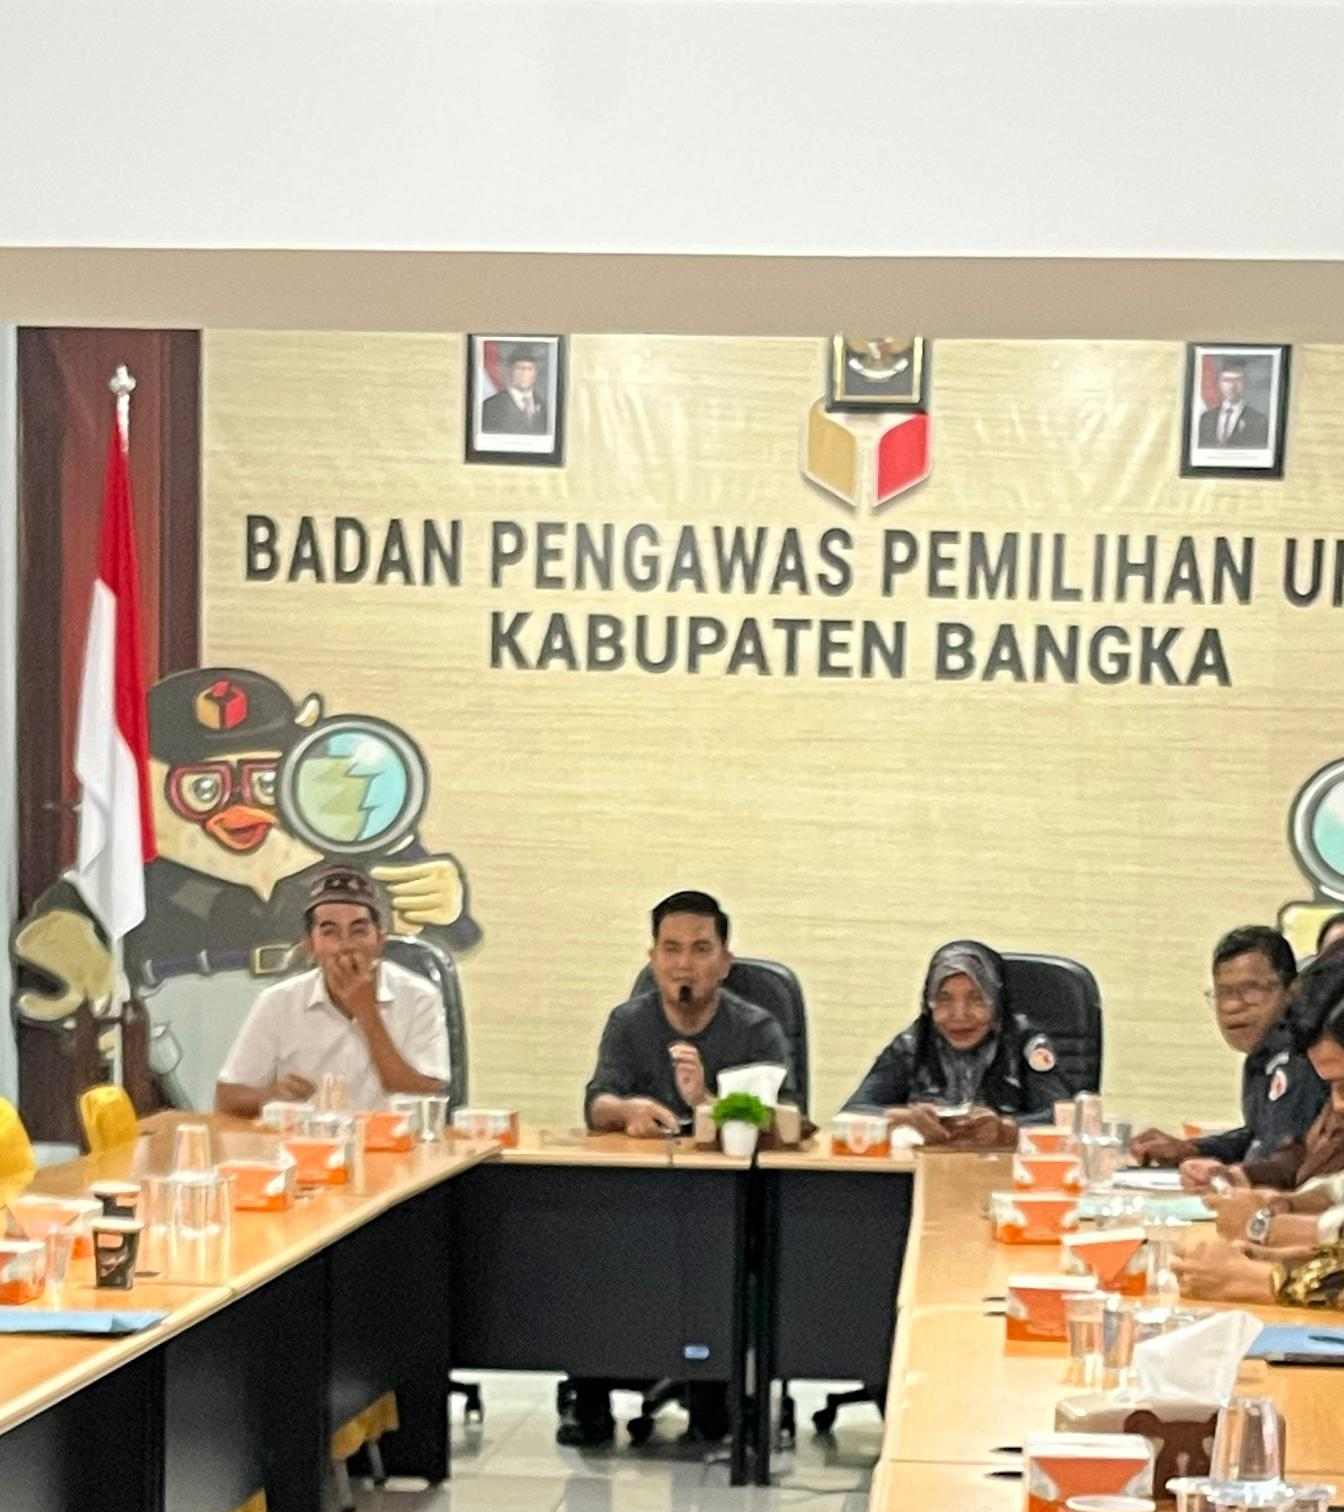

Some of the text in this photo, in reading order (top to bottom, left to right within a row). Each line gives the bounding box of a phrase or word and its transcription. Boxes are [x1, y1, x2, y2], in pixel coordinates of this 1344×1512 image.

[245, 514, 460, 586] BADAN
[490, 521, 852, 595] PENGAWAS
[883, 529, 1255, 604] PEMILIHAN
[490, 611, 1231, 687] KABUPATEN BANGKA
